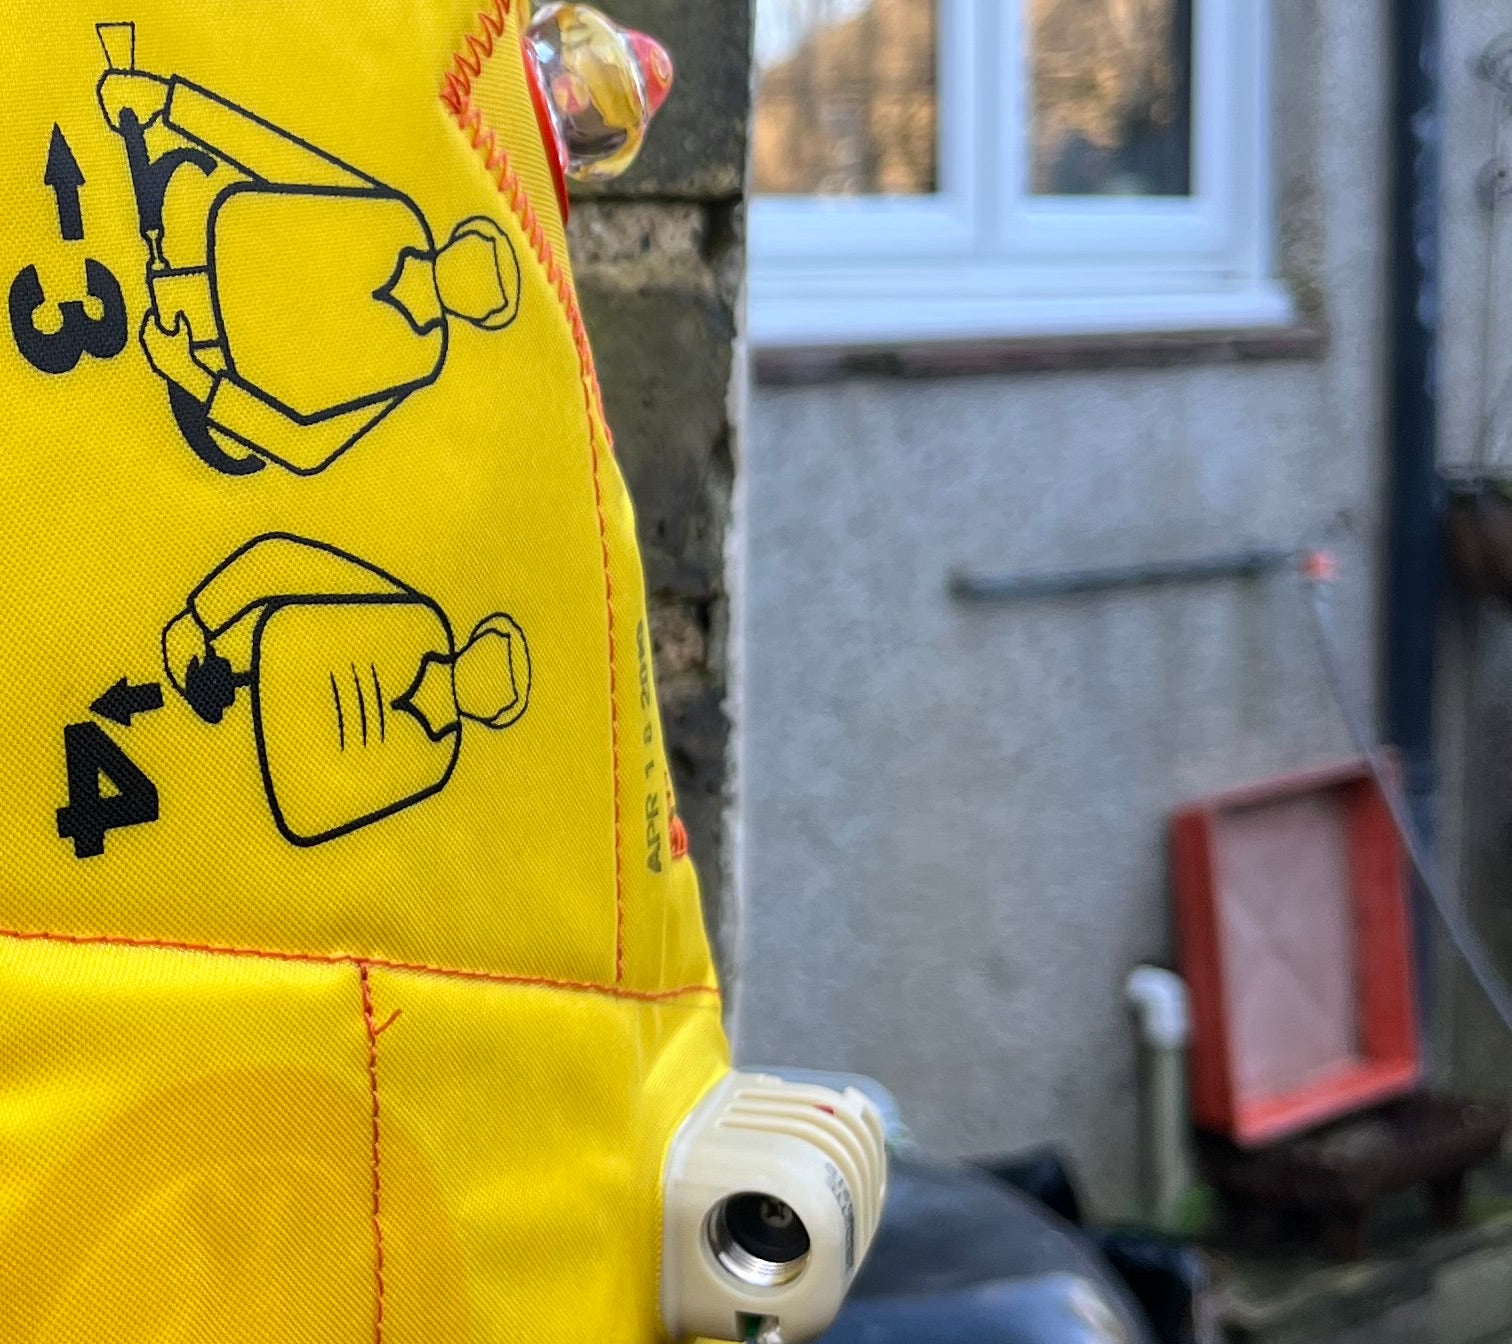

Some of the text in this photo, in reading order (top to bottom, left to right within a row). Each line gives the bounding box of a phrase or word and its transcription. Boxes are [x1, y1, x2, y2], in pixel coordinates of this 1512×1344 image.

[8, 258, 128, 375] 3
[55, 720, 160, 860] 4
[645, 791, 662, 873] APR
